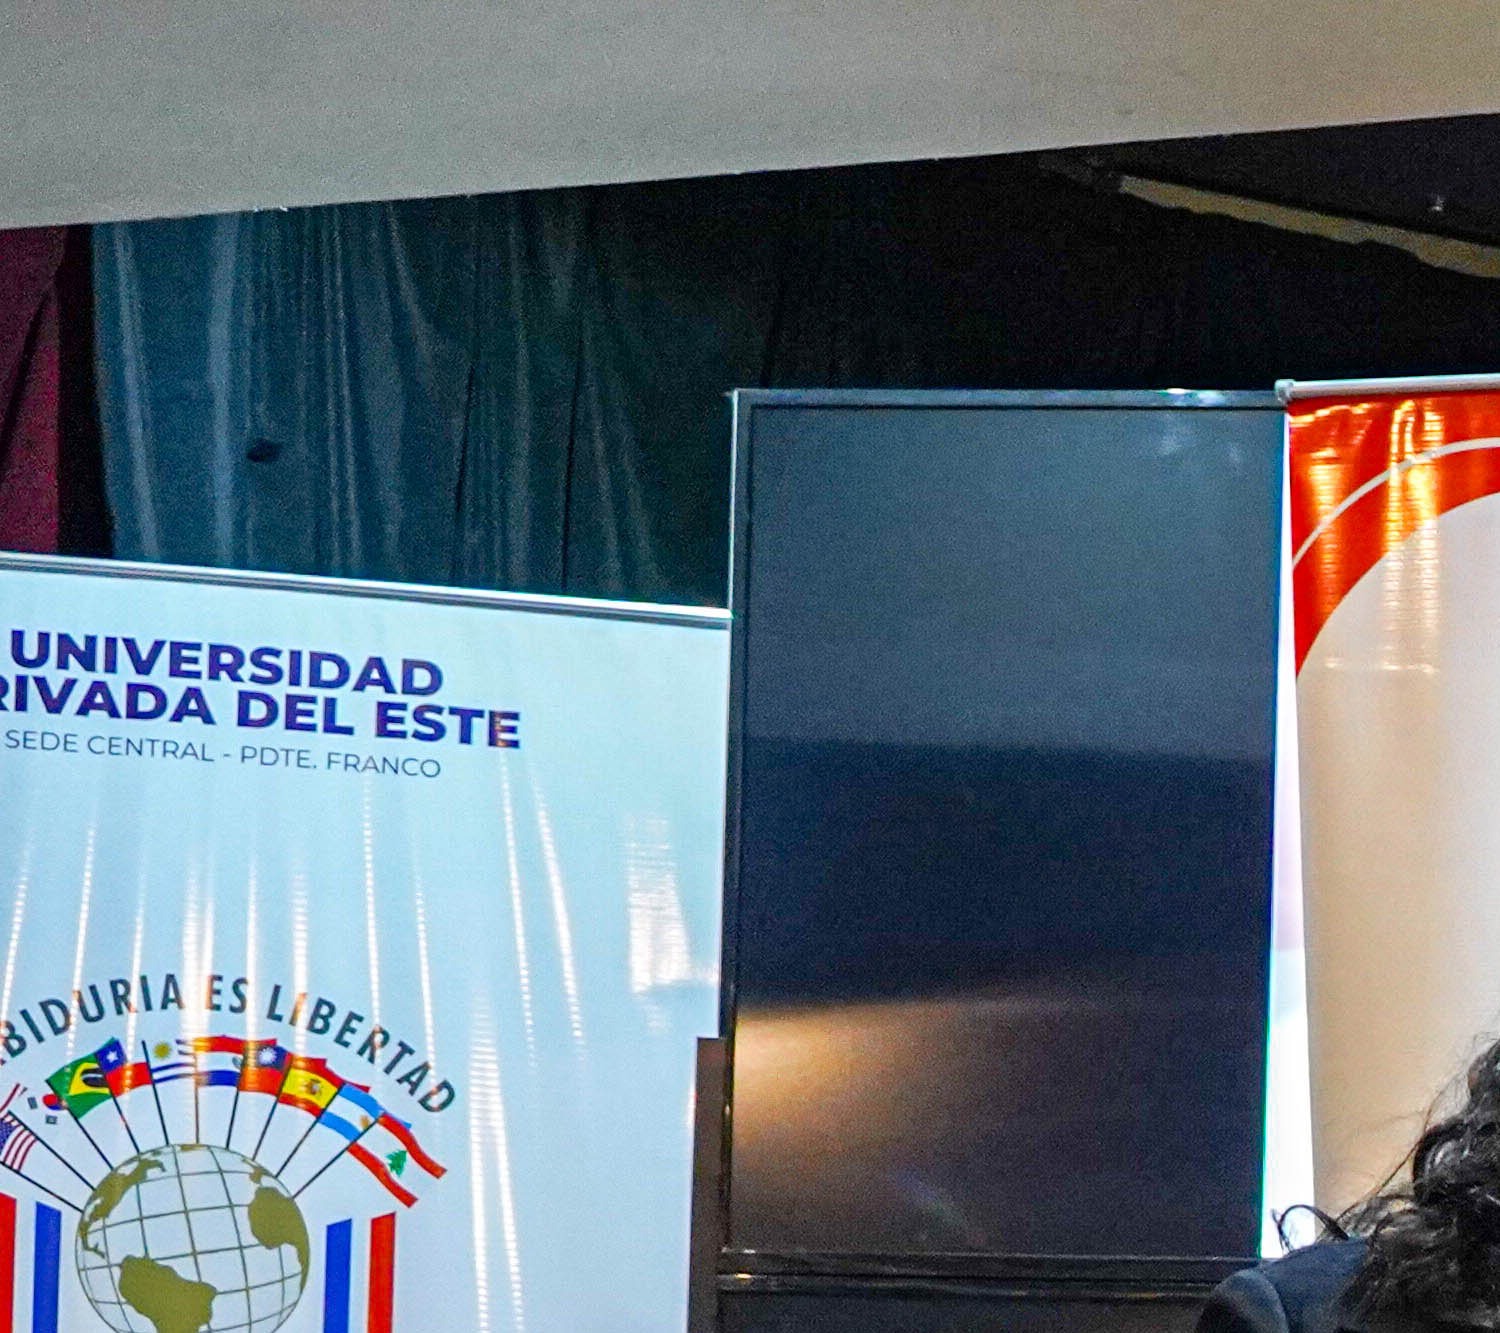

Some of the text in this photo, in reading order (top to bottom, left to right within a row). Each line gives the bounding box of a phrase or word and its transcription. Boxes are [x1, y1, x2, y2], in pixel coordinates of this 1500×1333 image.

[10, 629, 443, 697] UNIVERSIDAD
[0, 675, 520, 749] IVADA DEL ESTE
[4, 729, 79, 754] SEDE
[87, 733, 215, 764] CENTRAL
[240, 744, 318, 771] PDTE.
[327, 752, 442, 779] FRANCO
[0, 973, 458, 1114] BIDURIA ES LIBERTAD
